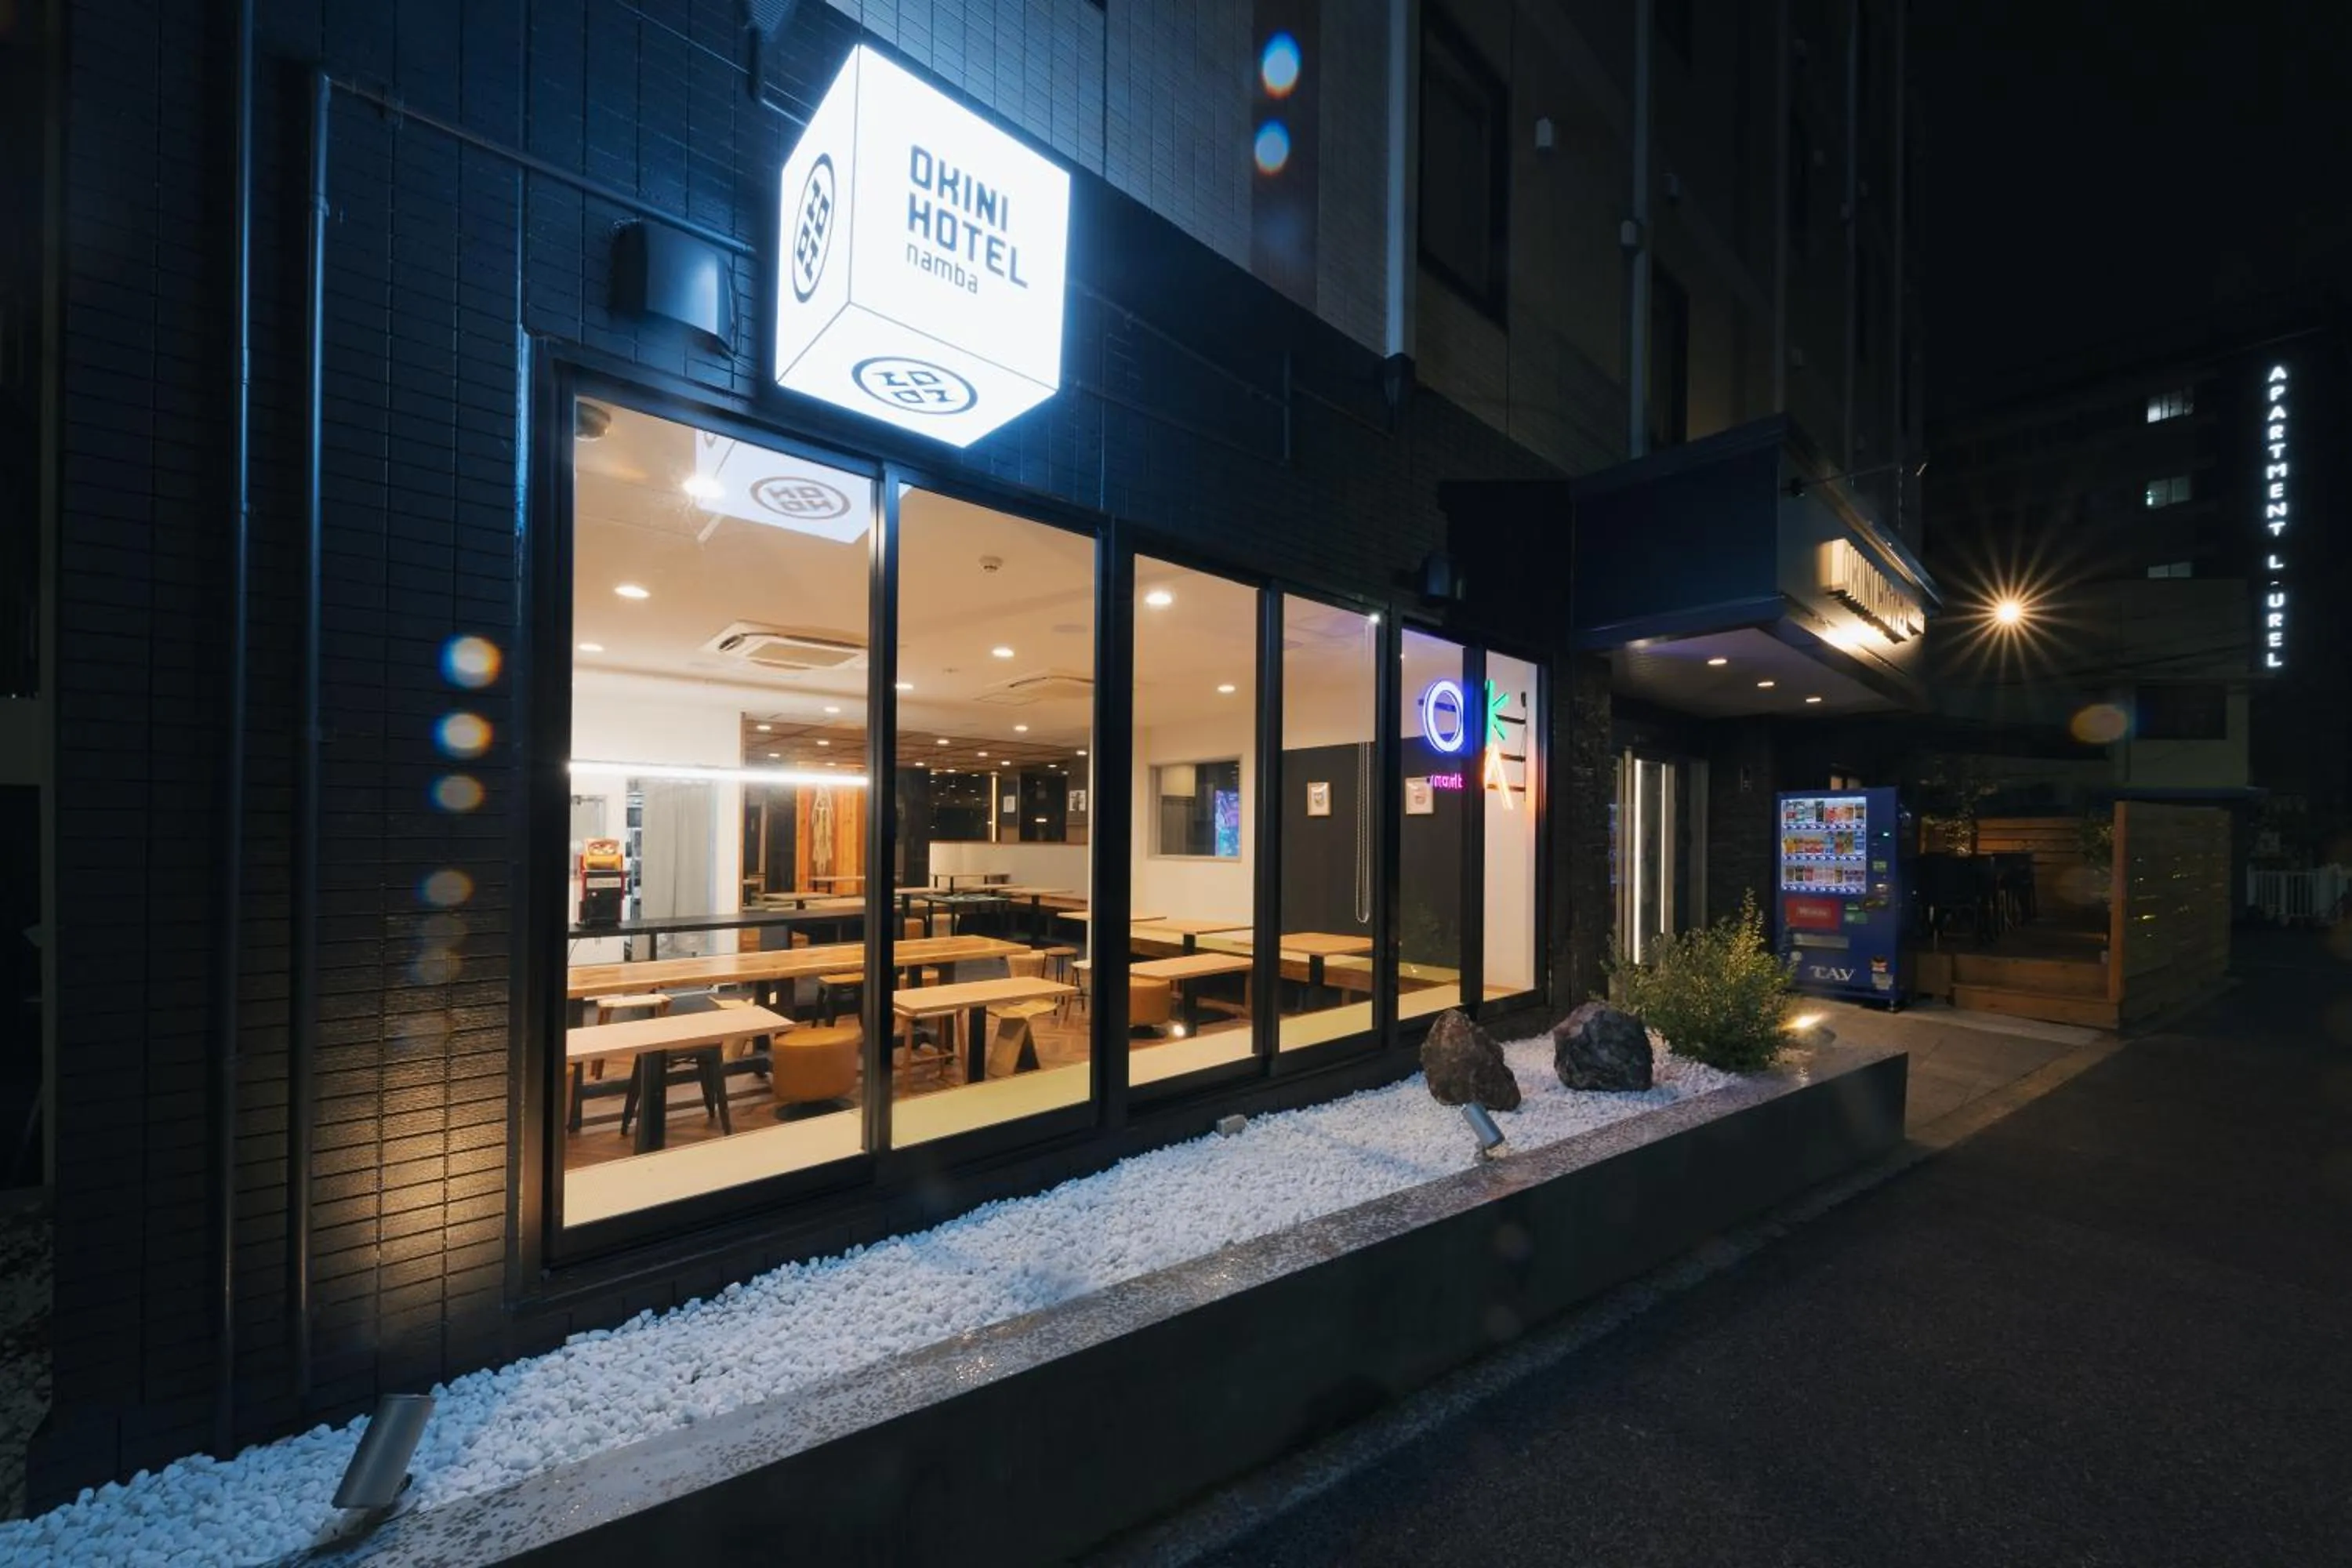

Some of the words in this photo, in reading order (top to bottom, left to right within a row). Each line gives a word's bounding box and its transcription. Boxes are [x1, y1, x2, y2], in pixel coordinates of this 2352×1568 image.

[909, 144, 1009, 234] OKINI
[906, 242, 978, 296] namba
[907, 191, 1029, 289] HOTEL
[2266, 365, 2288, 536] APARTMENT
[2266, 554, 2285, 668] LUREL
